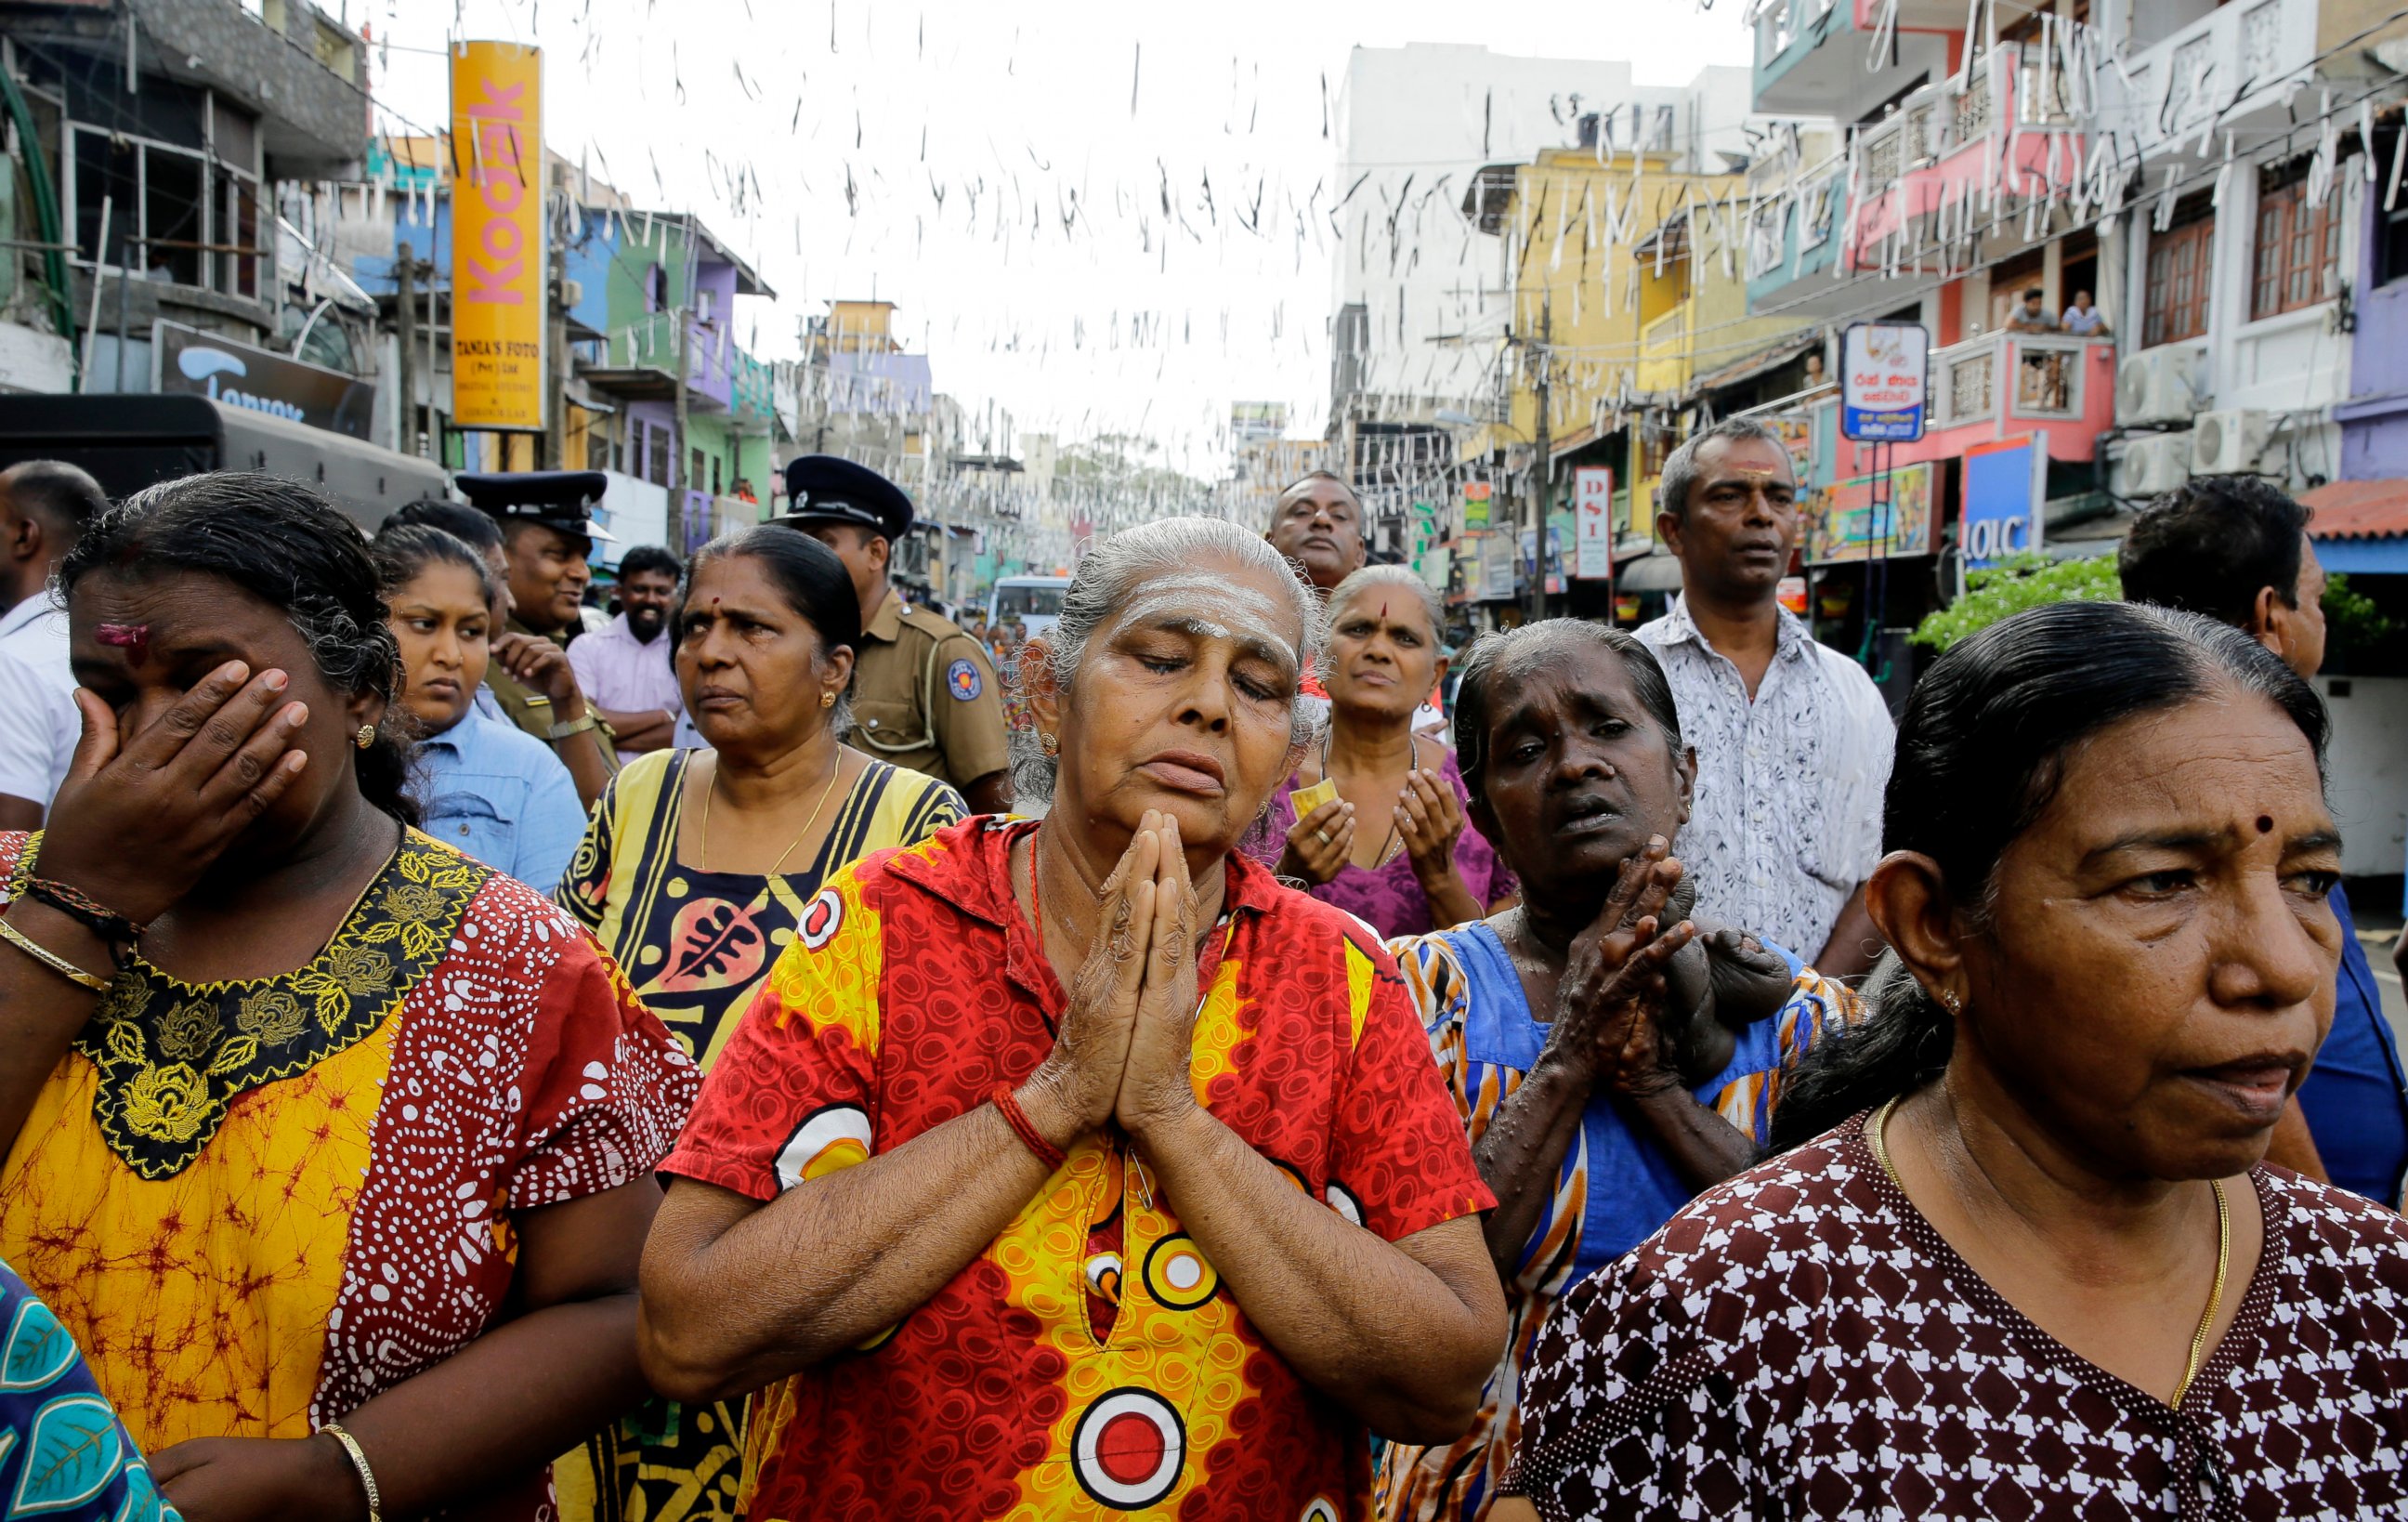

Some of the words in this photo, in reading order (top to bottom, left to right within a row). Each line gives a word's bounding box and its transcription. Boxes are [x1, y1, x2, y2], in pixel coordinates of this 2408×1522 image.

[467, 76, 525, 306] Kodak
[505, 342, 539, 359] FOTO
[1960, 516, 2022, 559] LOLC
